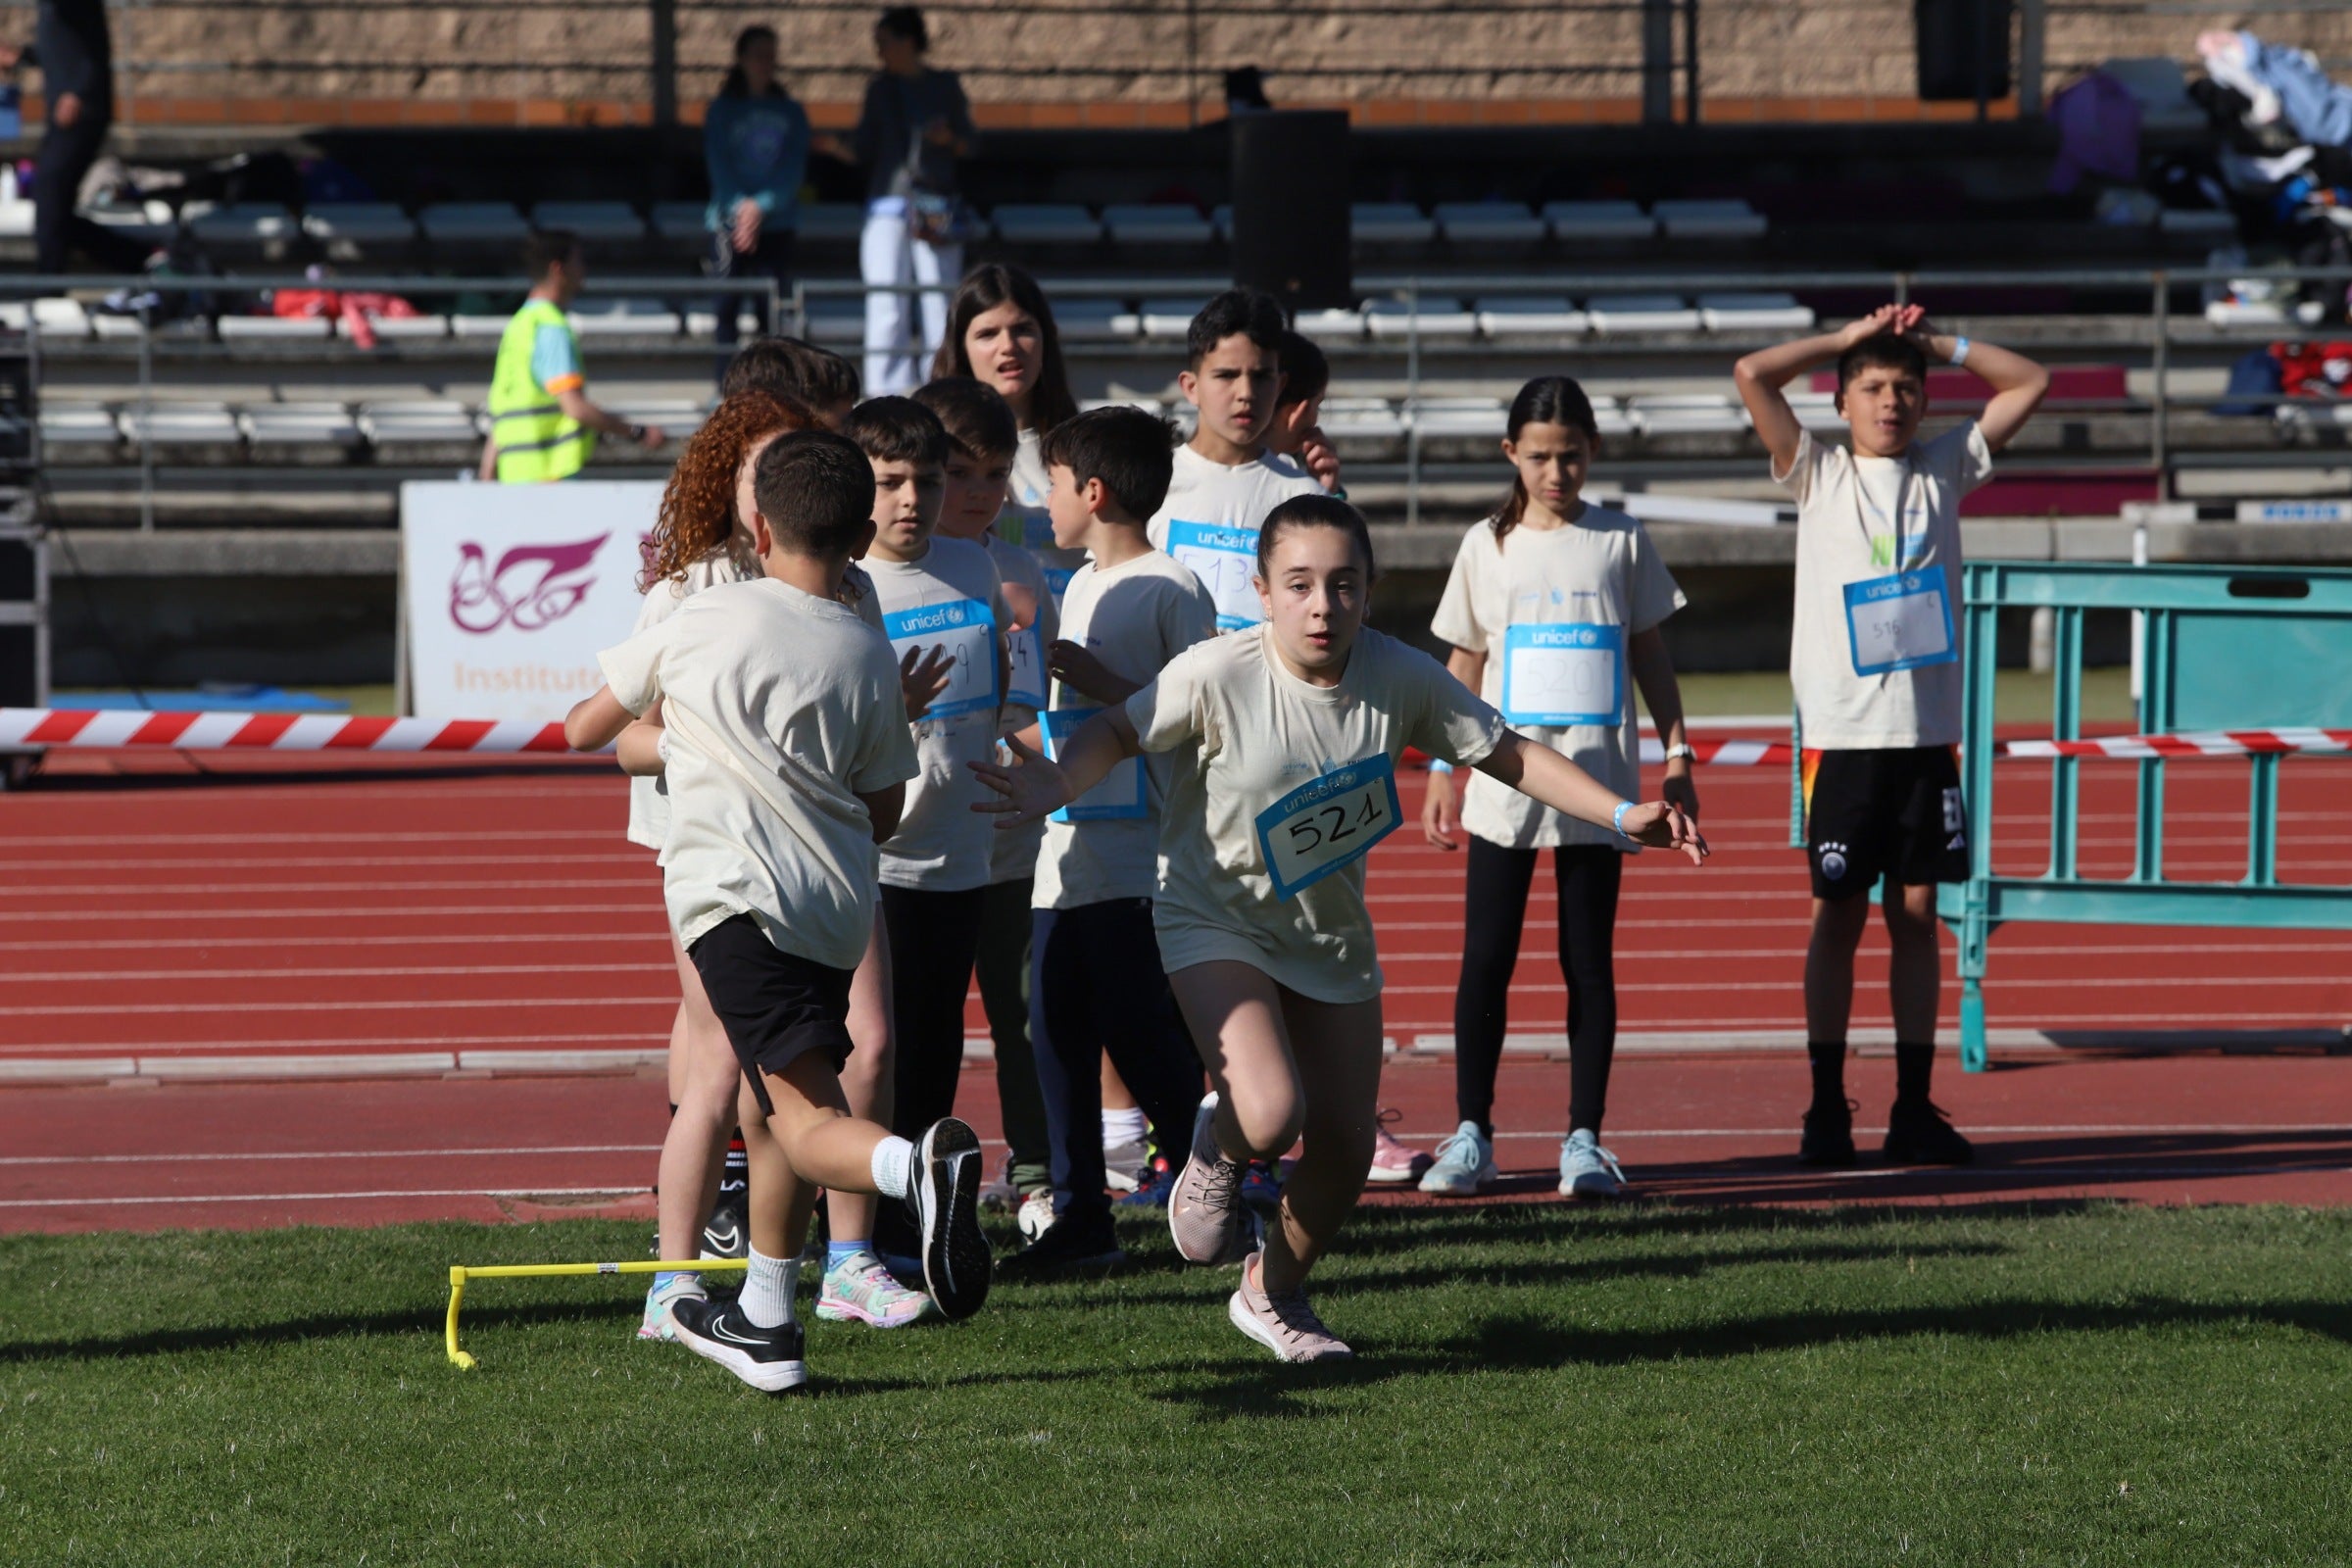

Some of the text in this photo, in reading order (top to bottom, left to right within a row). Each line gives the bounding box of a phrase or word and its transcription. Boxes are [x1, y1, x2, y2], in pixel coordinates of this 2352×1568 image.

[1197, 531, 1246, 549] unicef
[901, 609, 947, 633] unicef
[1532, 628, 1578, 645] unicef
[1527, 658, 1594, 697] 520
[1284, 776, 1336, 814] unicef
[1289, 792, 1383, 856] 521
